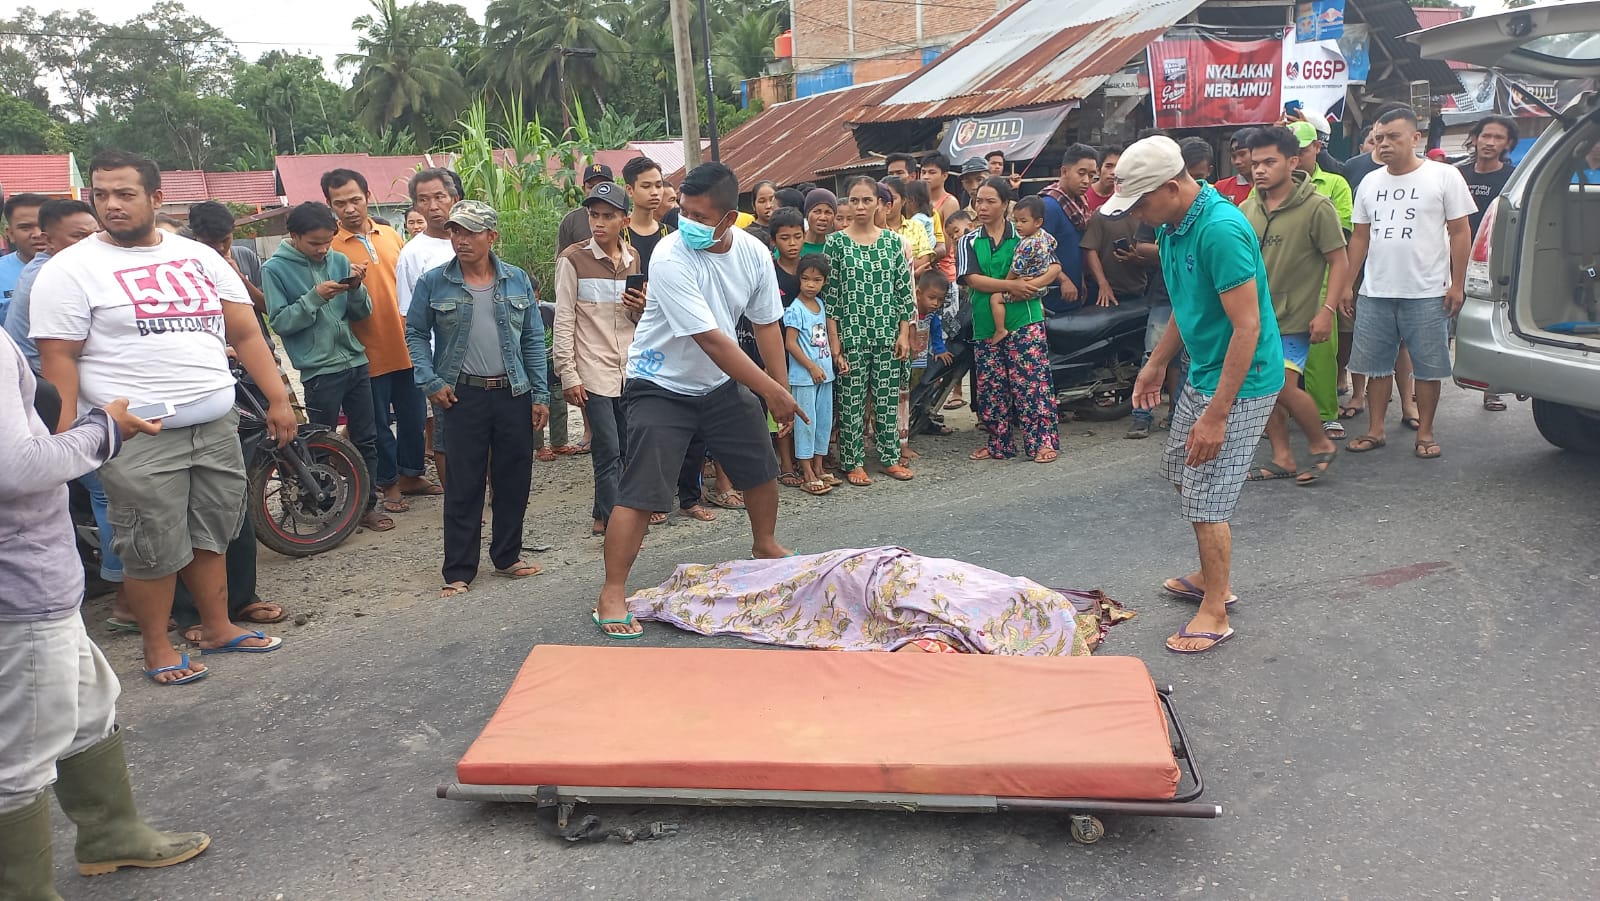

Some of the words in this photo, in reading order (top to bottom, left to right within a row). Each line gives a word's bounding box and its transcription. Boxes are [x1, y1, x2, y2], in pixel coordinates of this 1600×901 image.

[1206, 63, 1274, 79] NYALAKAN
[1303, 60, 1346, 80] GGSP
[1204, 81, 1272, 98] MERAHMU!
[976, 121, 1019, 139] BULL
[1376, 187, 1420, 202] HOL
[1374, 207, 1416, 222] LIS
[1373, 226, 1413, 240] TER
